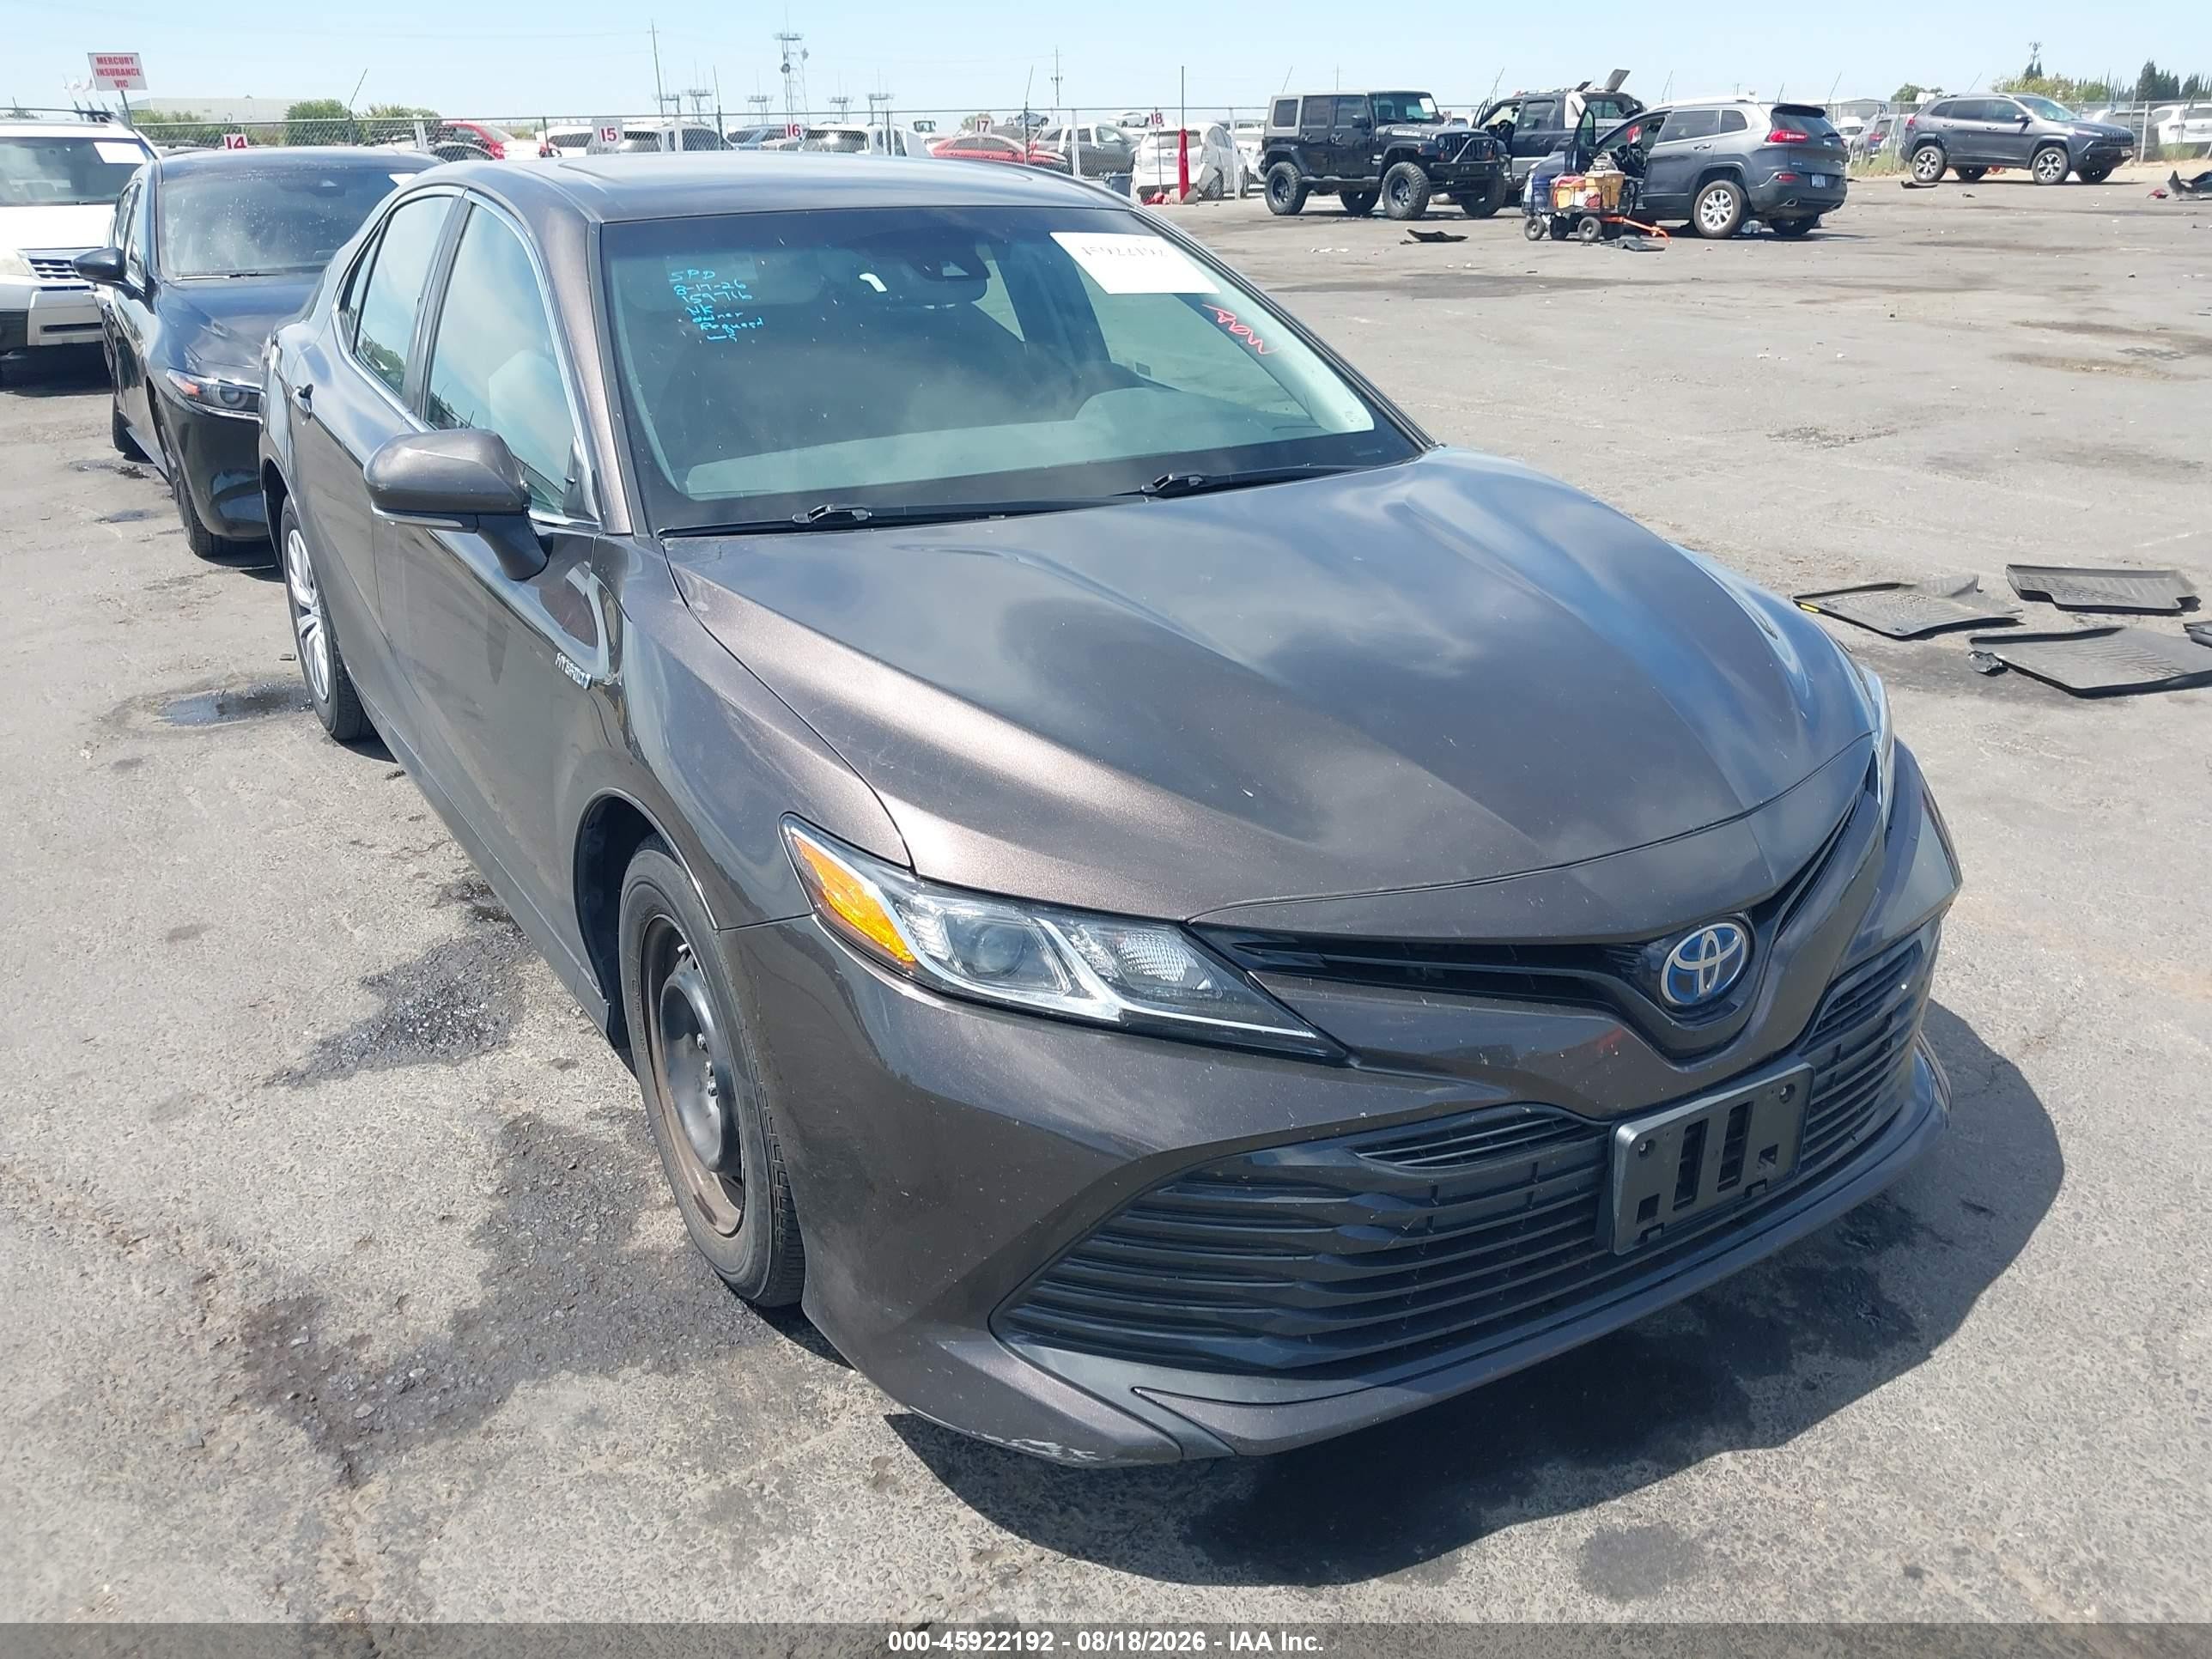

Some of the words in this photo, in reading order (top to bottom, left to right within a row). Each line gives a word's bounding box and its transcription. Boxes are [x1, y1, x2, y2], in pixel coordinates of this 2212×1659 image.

[95, 56, 134, 64] MERCURY
[95, 68, 141, 76] INSURANCE
[113, 79, 129, 88] VIC
[1151, 112, 1163, 125] 18
[787, 123, 801, 137] 16
[976, 120, 989, 133] 17
[600, 127, 617, 142] 15
[226, 136, 246, 149] 14
[669, 269, 715, 283] SPD
